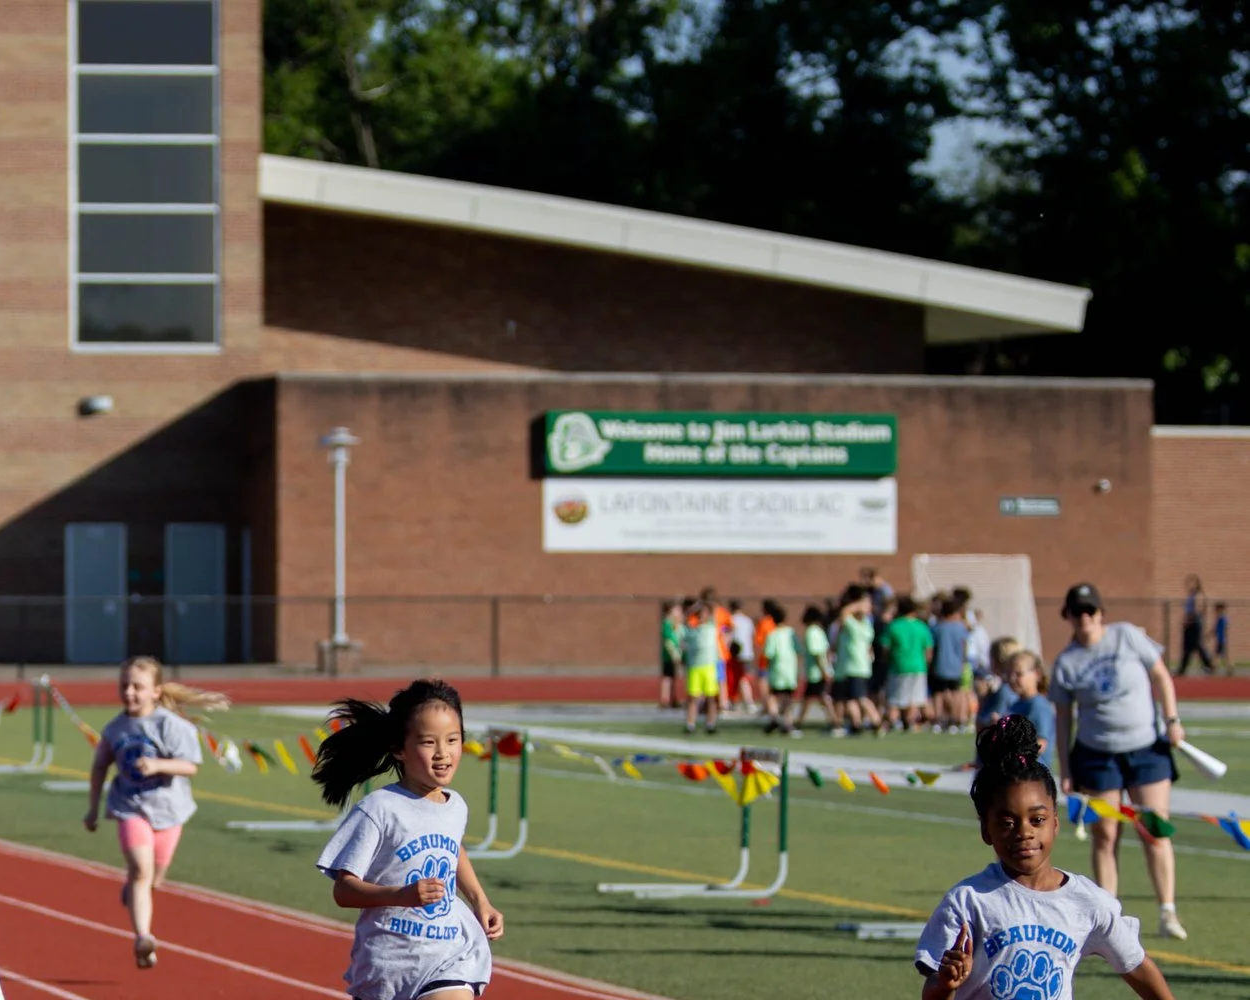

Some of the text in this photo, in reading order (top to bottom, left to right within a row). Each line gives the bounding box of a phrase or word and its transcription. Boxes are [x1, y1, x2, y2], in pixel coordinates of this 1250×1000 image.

[599, 419, 684, 440] Welcome
[687, 420, 710, 441] to
[812, 420, 892, 442] Stadium
[643, 442, 848, 468] Home of the Captains
[738, 492, 844, 516] CADILLAC
[396, 833, 460, 862] BEAUMO
[390, 917, 423, 937] RUN
